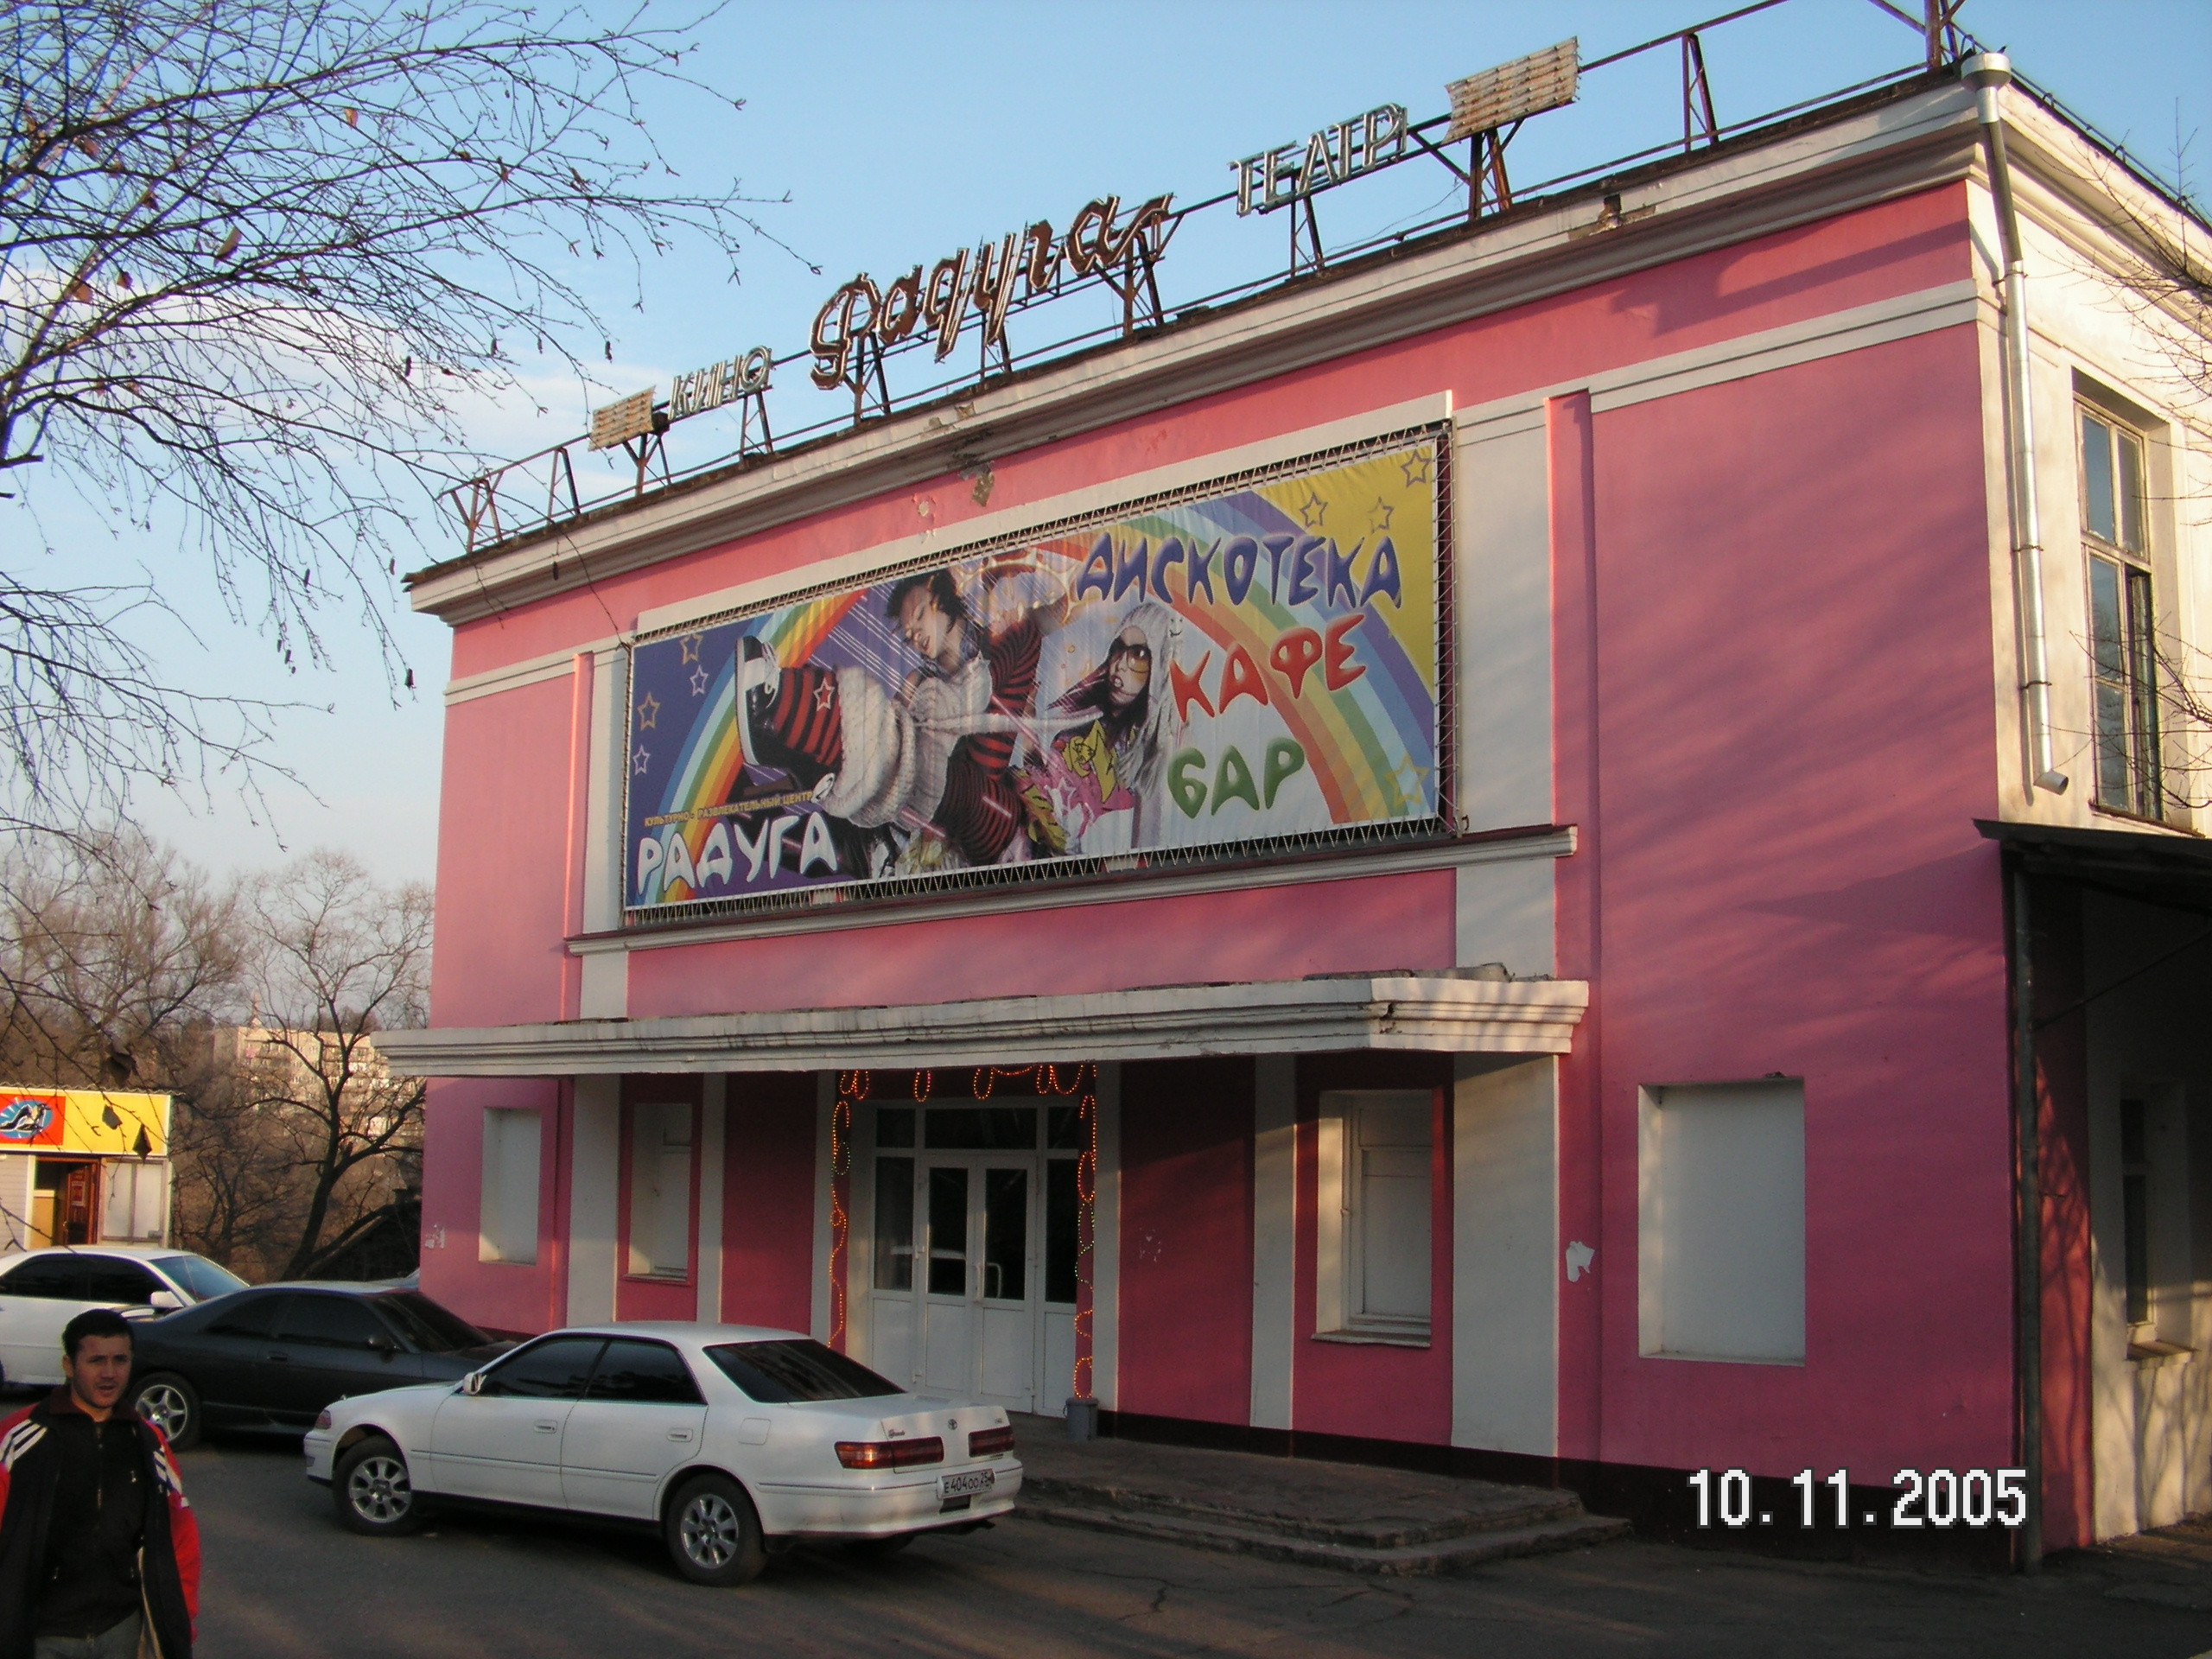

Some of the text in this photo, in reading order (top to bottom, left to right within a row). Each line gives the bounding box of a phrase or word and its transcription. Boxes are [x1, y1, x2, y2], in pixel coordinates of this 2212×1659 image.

[669, 345, 772, 421] КИНО
[1227, 103, 1408, 218] ТЕАТР
[1077, 532, 1402, 608] ДИСКОТЕКА
[1170, 614, 1366, 722] КАФЕ
[783, 791, 813, 804] ЦЕНТР
[1168, 737, 1306, 819] БАР
[638, 811, 837, 895] РАДУГА
